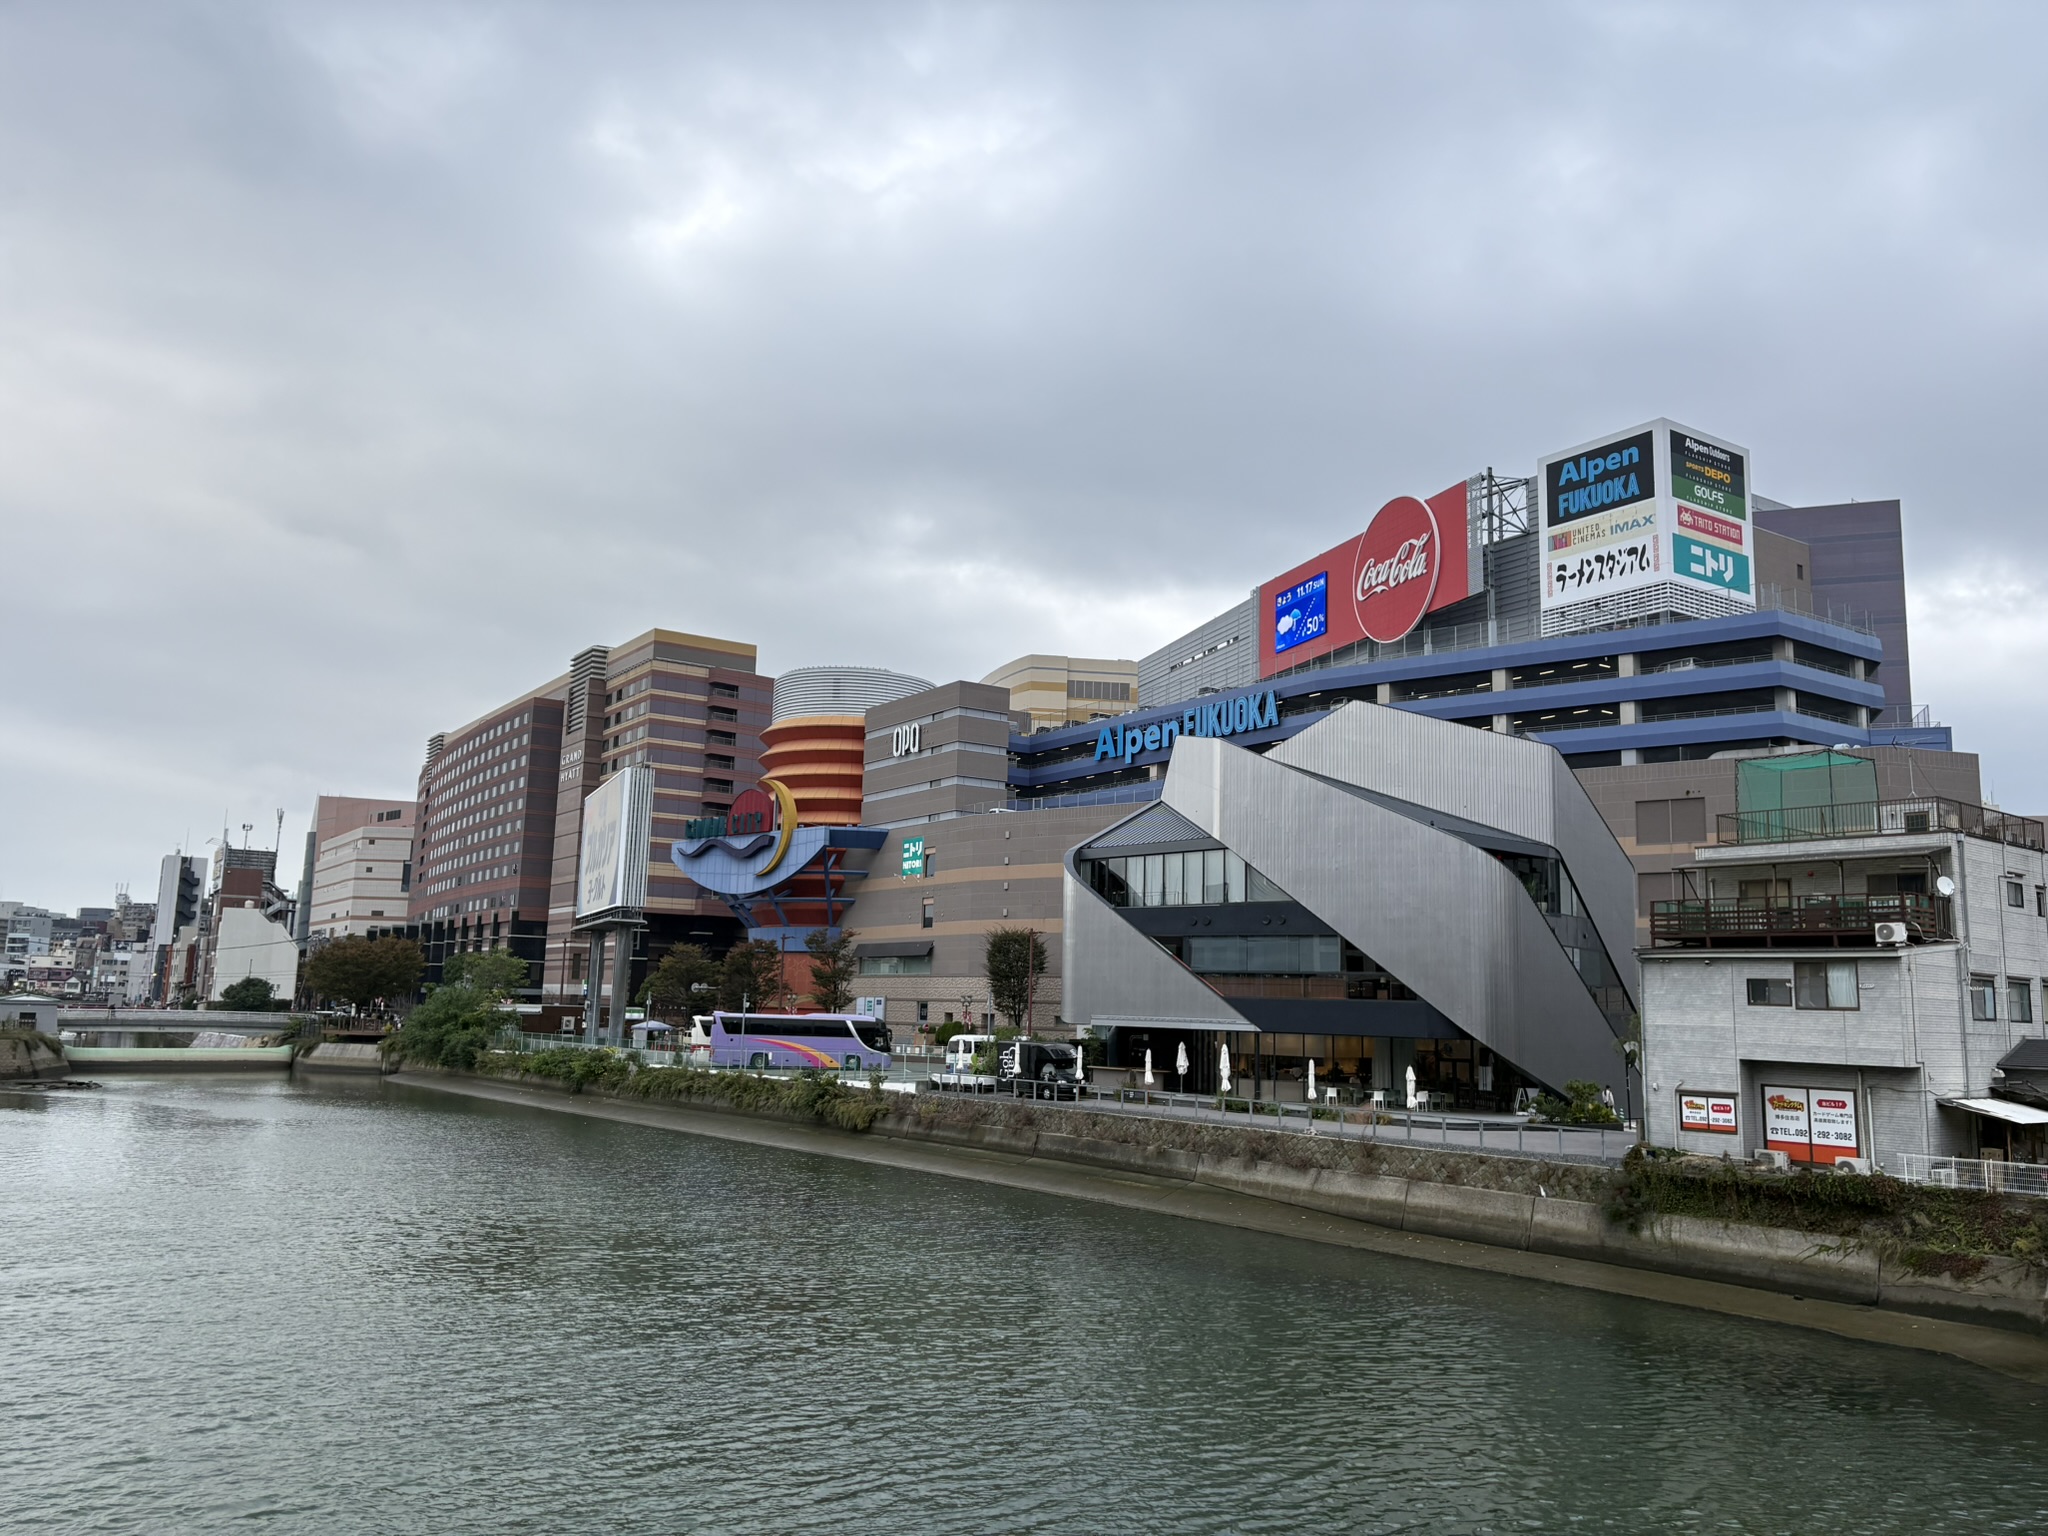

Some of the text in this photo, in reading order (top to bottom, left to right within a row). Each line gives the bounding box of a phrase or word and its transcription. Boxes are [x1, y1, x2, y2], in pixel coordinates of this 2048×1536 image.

[1685, 437, 1730, 462] Alpen Outdoors
[1685, 450, 1712, 463] FLAGSHIP
[1558, 445, 1639, 486] Alpen
[1686, 461, 1731, 484] SPORTS DEPO
[1685, 473, 1712, 485] FLAGSHIP
[1558, 472, 1640, 518] FUKUOKA
[1694, 485, 1724, 504] GOLF5
[1572, 523, 1600, 537] UNITED
[1610, 514, 1654, 535] IMAX
[1694, 516, 1741, 540] TAITO STATION
[1572, 530, 1606, 545] CINEMAS
[1356, 529, 1432, 601] Coca-Cola
[1556, 544, 1650, 592] ラーメンスタジアム
[1690, 544, 1733, 582] ニトリ
[1277, 578, 1324, 607] きょう 11.17 SUN
[1094, 690, 1279, 764] Alpen FUKUOKA
[561, 749, 582, 766] GRAND
[560, 767, 581, 783] HYATT
[903, 841, 923, 858] ニトリ
[903, 859, 922, 870] NITORI
[1780, 1127, 1853, 1141] TEL.092 -292-3082
